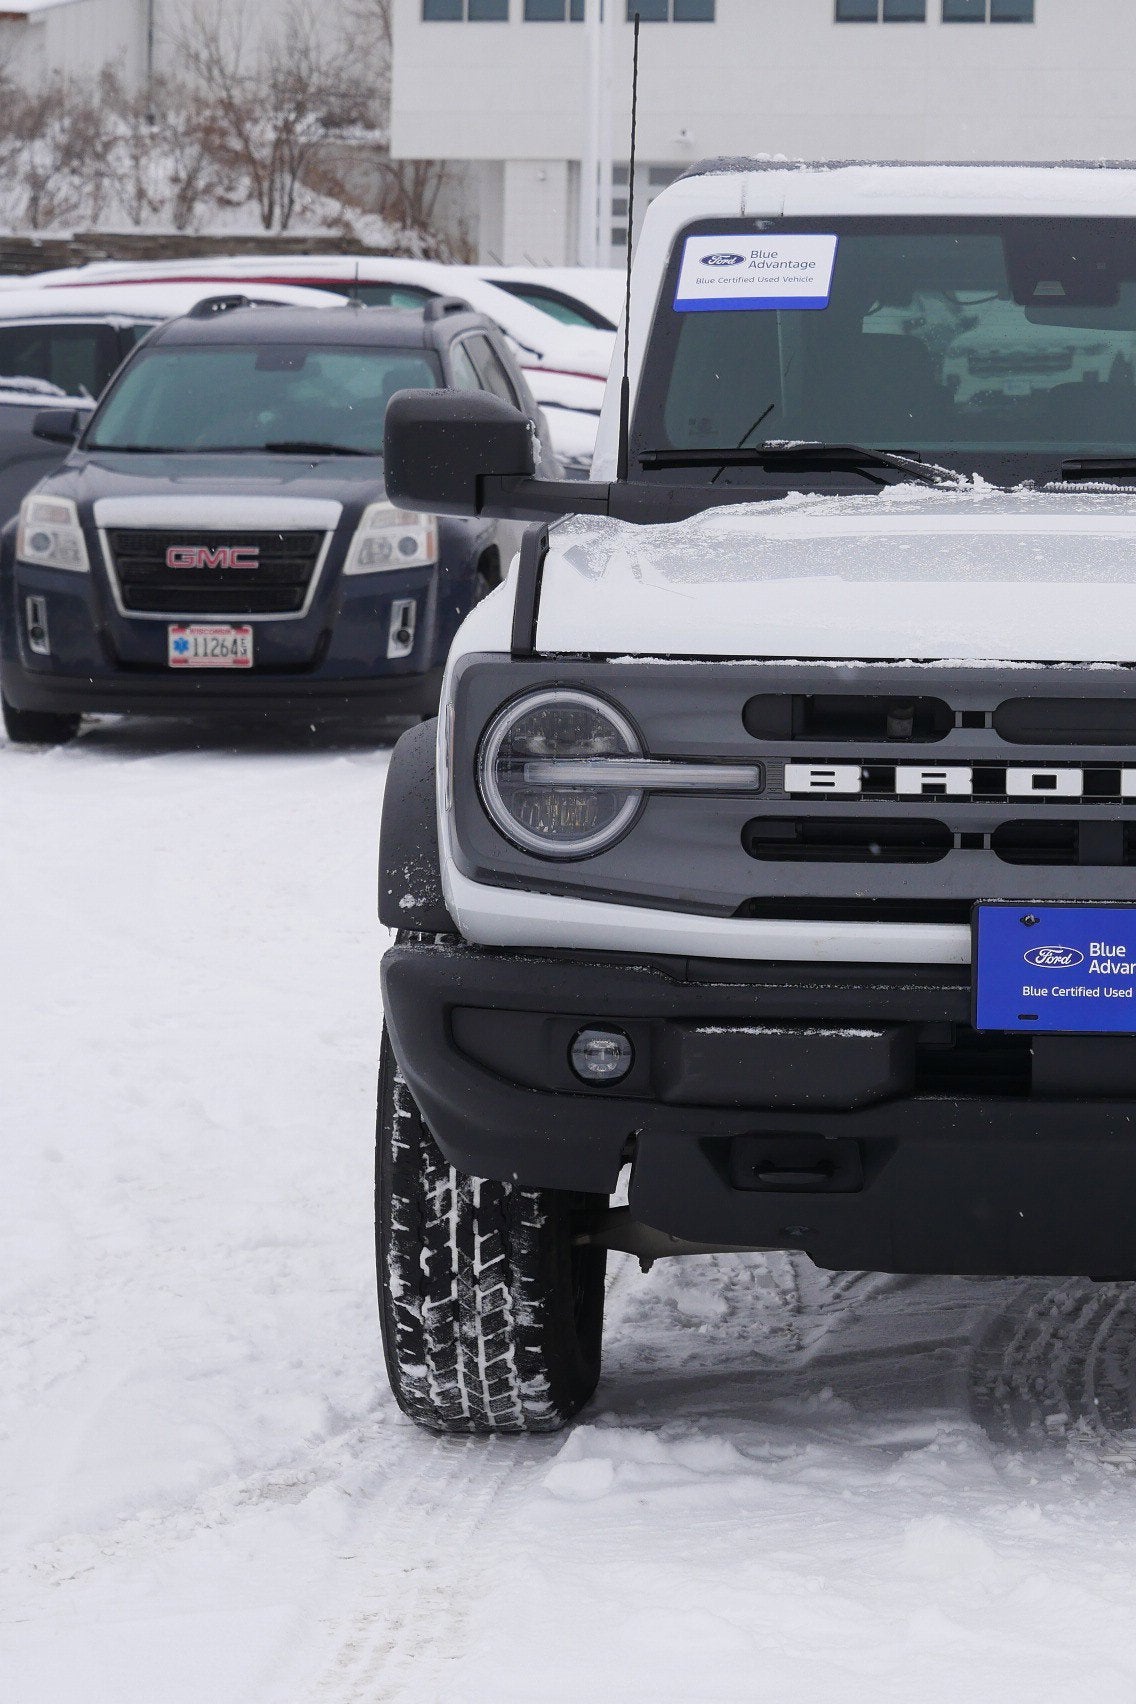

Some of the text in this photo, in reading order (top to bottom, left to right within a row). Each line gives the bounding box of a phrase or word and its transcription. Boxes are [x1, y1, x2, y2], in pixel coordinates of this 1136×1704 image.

[707, 255, 738, 265] Ford
[750, 250, 778, 259] Blue
[748, 260, 816, 270] Advantage
[695, 277, 716, 285] Blue
[717, 276, 755, 284] Certified
[166, 546, 259, 569] GMC
[1089, 942, 1126, 957] Blue
[1035, 949, 1074, 966] Ford
[1022, 986, 1048, 997] Blue
[1051, 986, 1100, 998] Certified
[1103, 987, 1133, 998] Used
